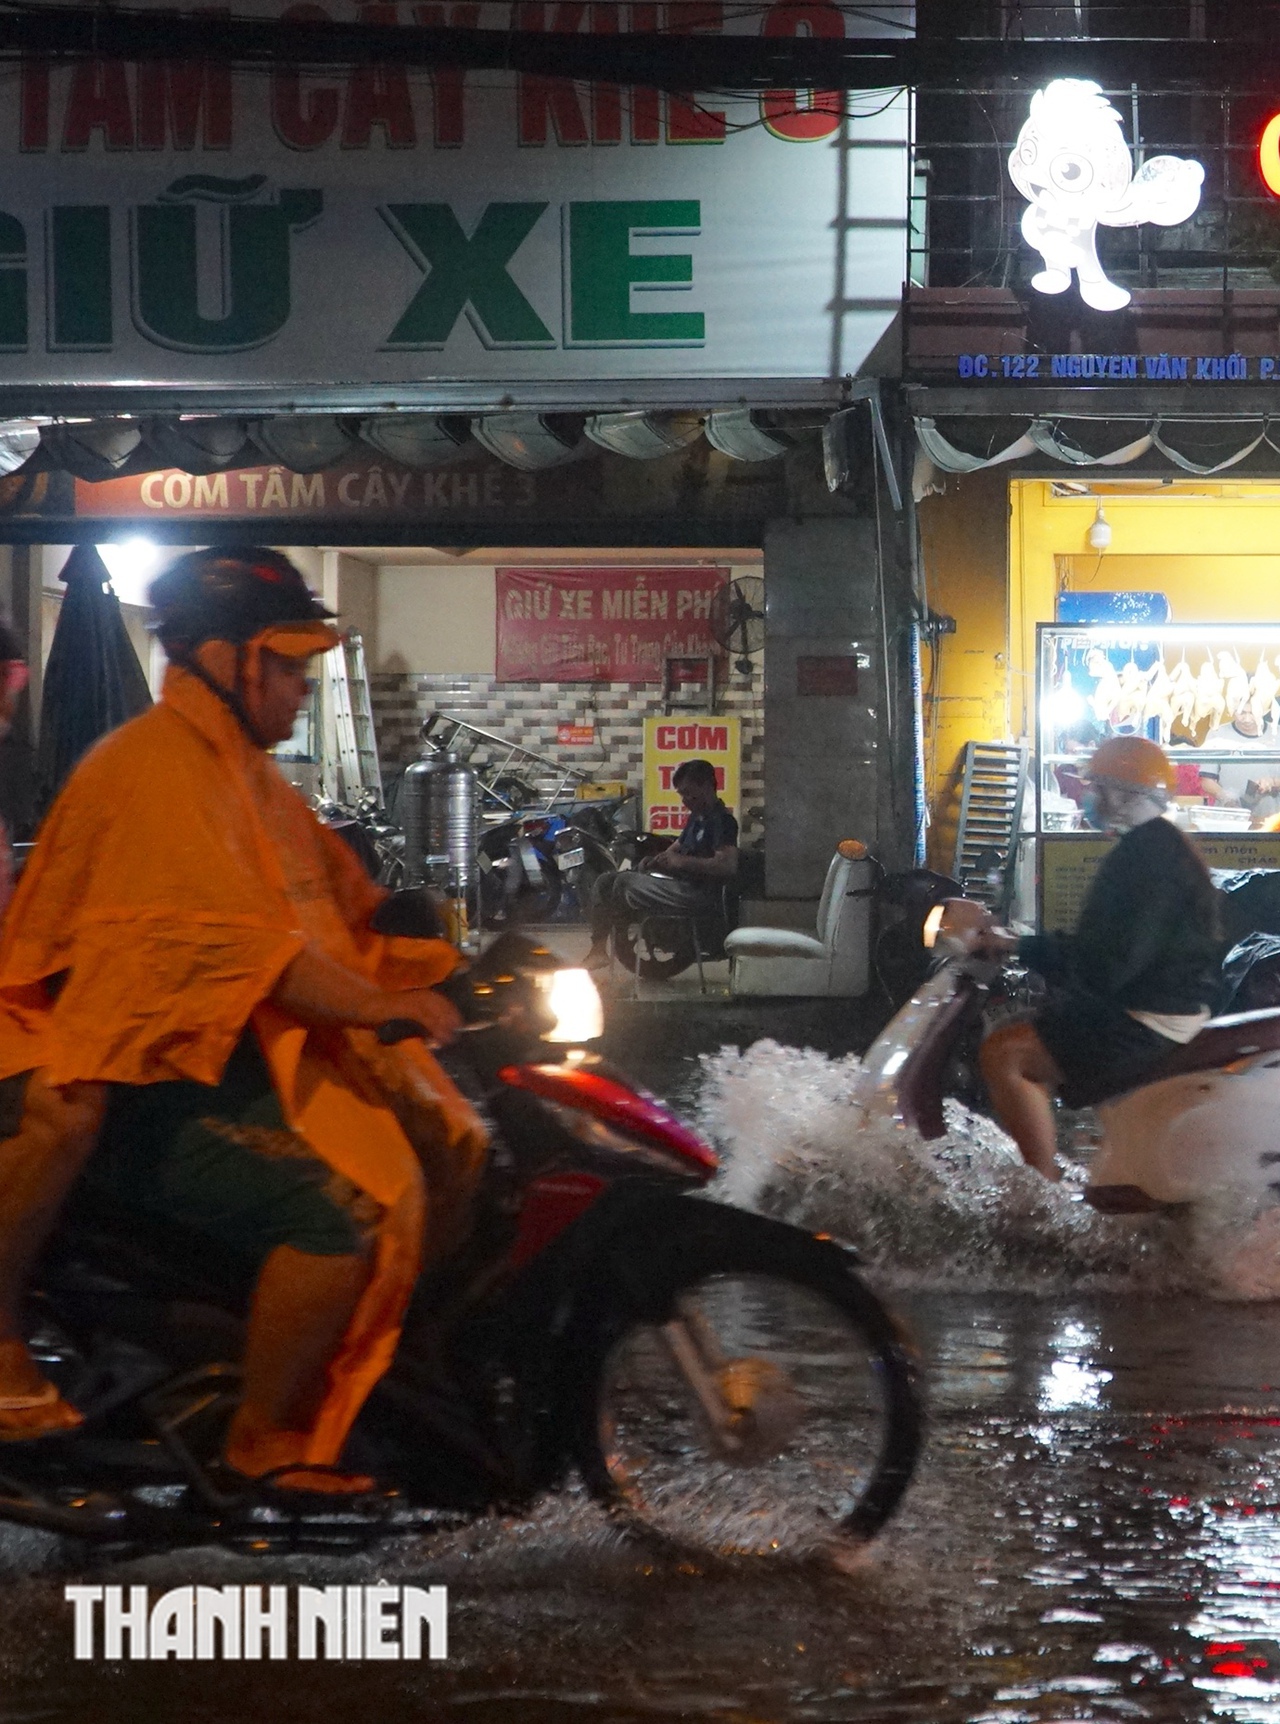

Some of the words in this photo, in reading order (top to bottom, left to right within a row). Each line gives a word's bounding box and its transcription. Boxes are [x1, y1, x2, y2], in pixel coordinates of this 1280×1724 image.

[0, 173, 323, 354] IỮ
[376, 199, 706, 350] XE
[1145, 352, 1188, 380] VĂN
[141, 472, 229, 508] CƠM
[559, 589, 594, 621] XE
[657, 723, 728, 750] CƠM
